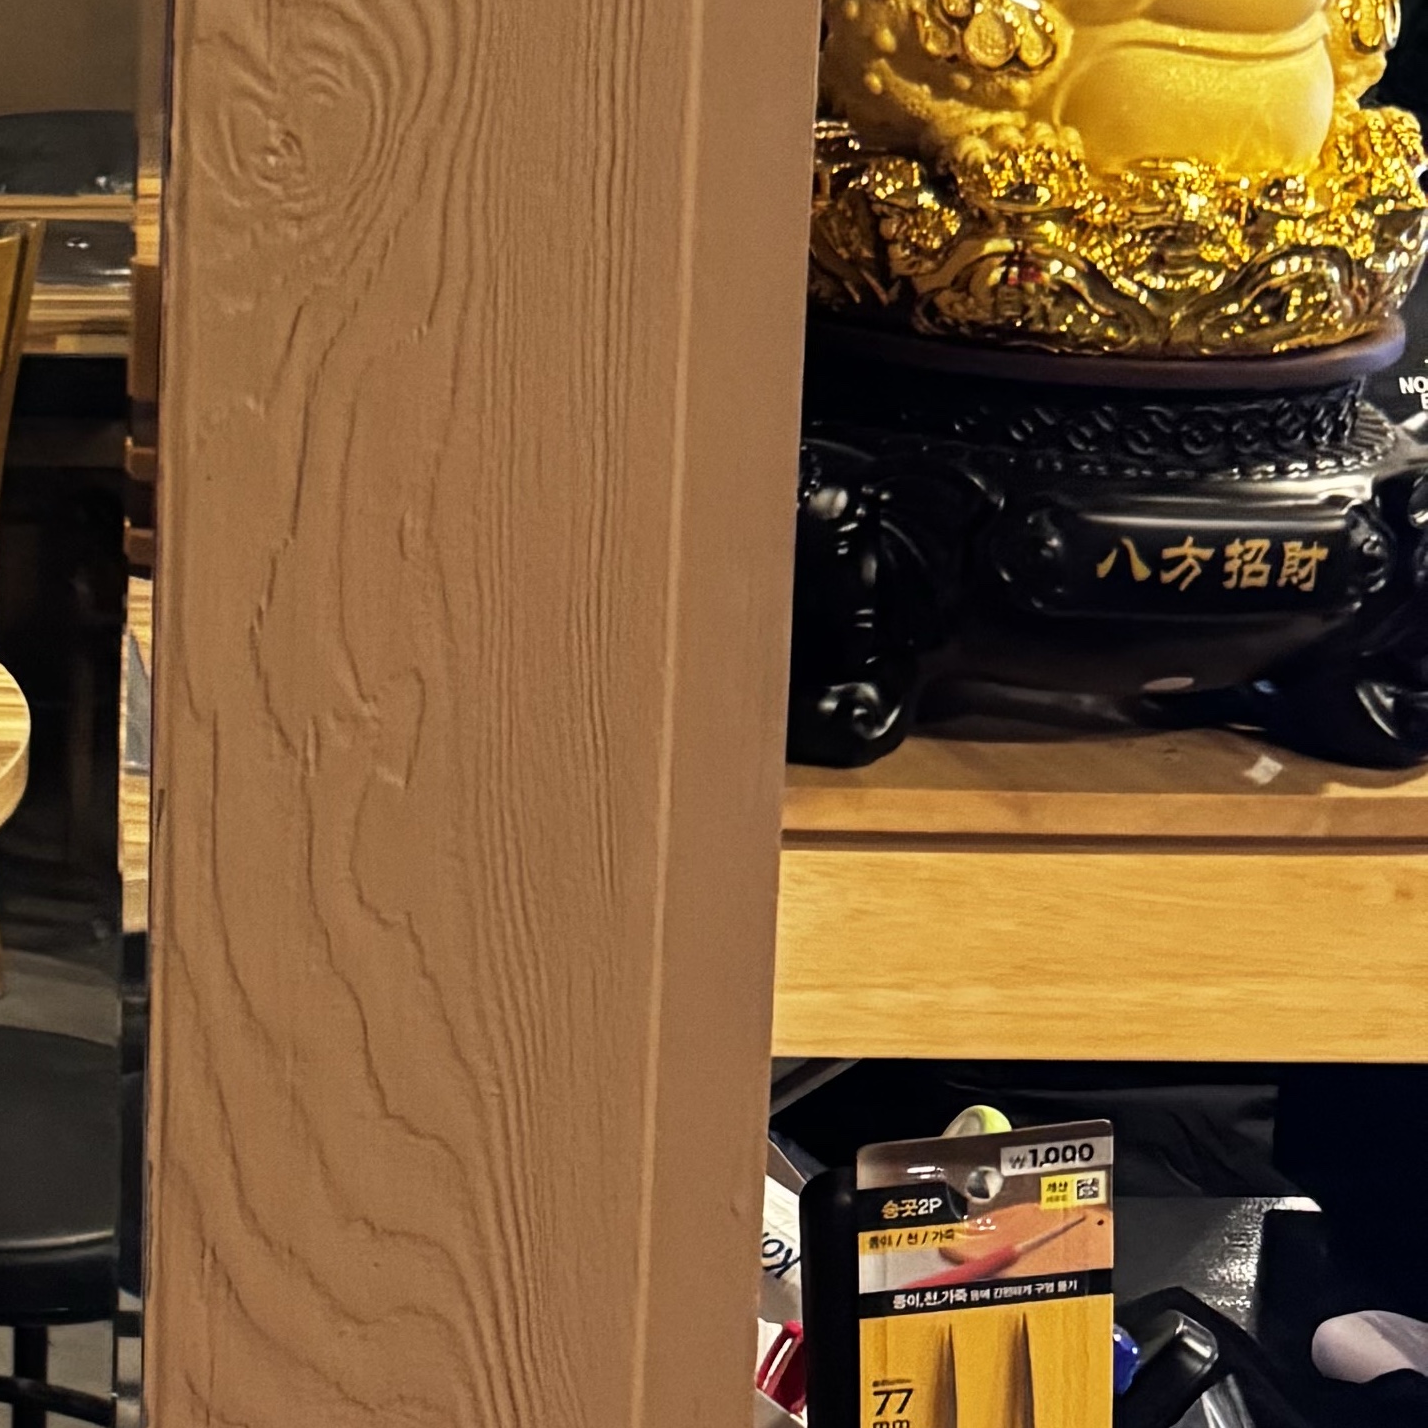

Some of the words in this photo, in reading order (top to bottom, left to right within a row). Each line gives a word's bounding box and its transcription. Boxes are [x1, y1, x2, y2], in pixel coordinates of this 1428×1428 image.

[1096, 535, 1329, 592] 八方招財
[881, 1197, 943, 1220] 송곳2P
[873, 1388, 913, 1416] 77
